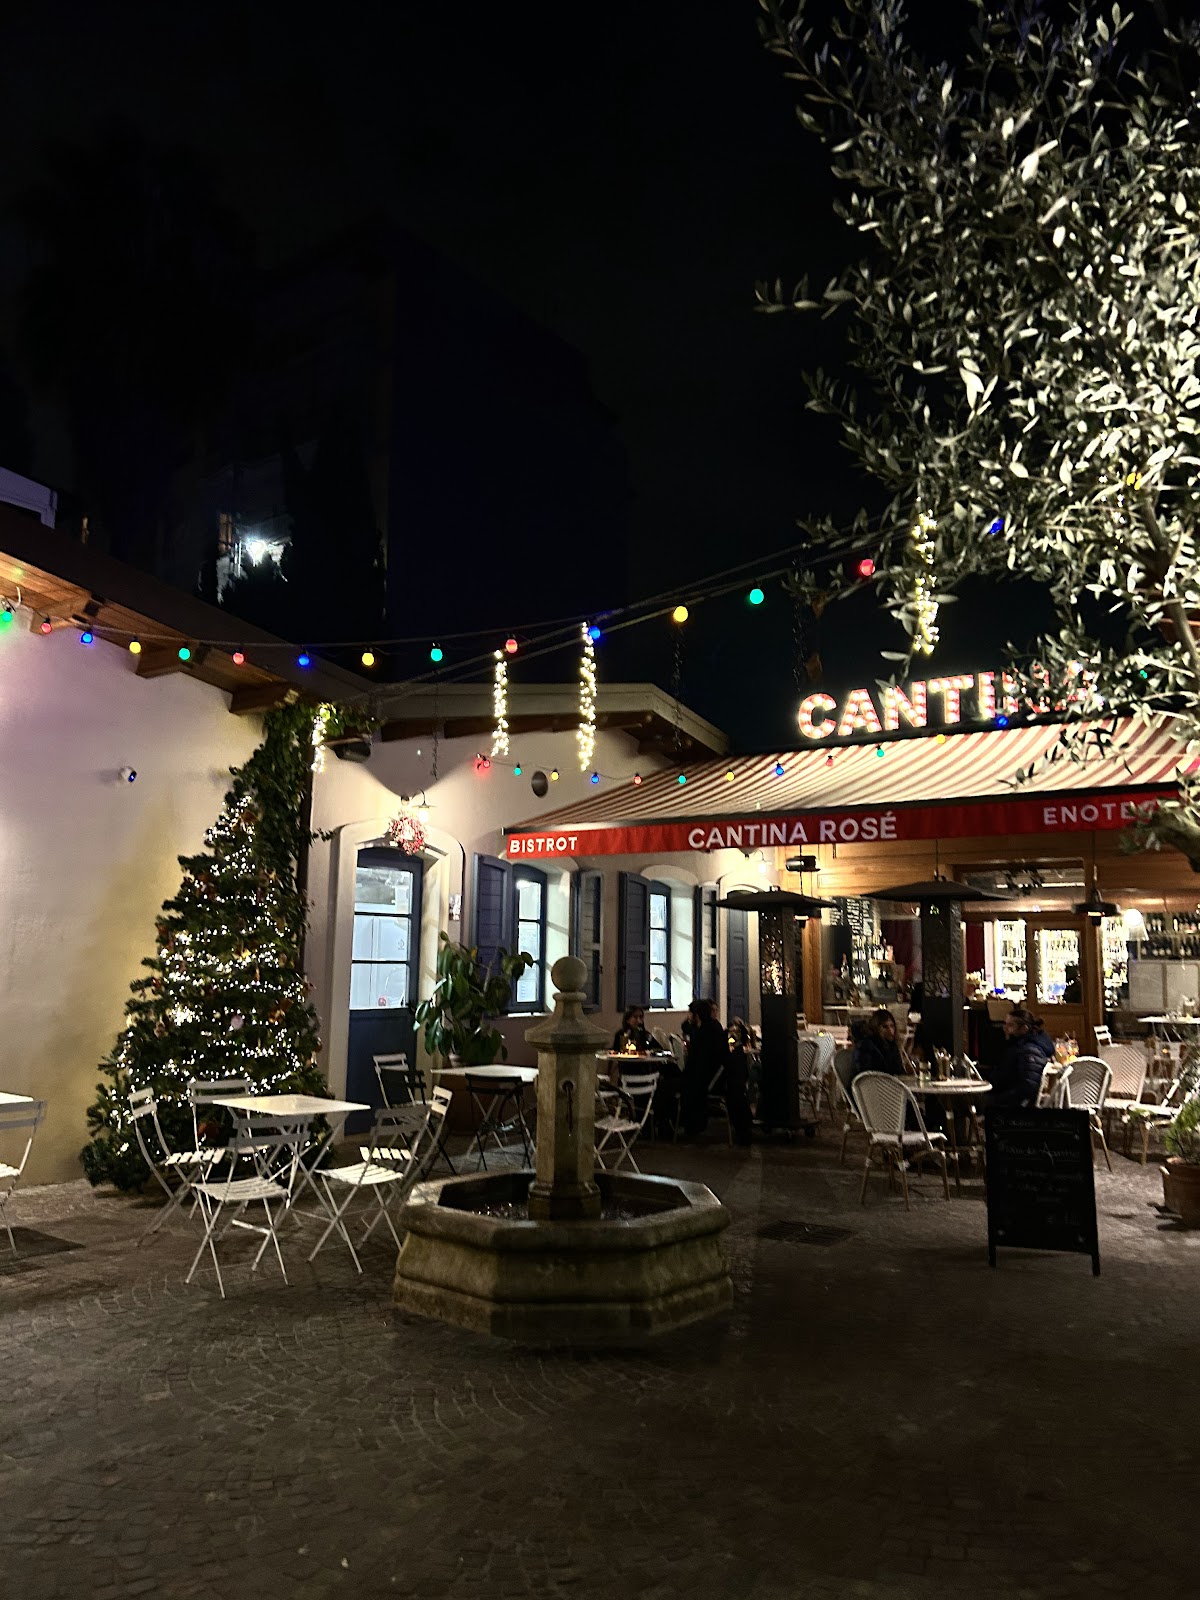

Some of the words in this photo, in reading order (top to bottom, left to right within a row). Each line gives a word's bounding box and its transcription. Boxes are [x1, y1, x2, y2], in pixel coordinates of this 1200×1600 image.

[688, 822, 808, 849] CANTINA
[819, 811, 898, 842] ROSÉ
[509, 836, 578, 854] BISTROT
